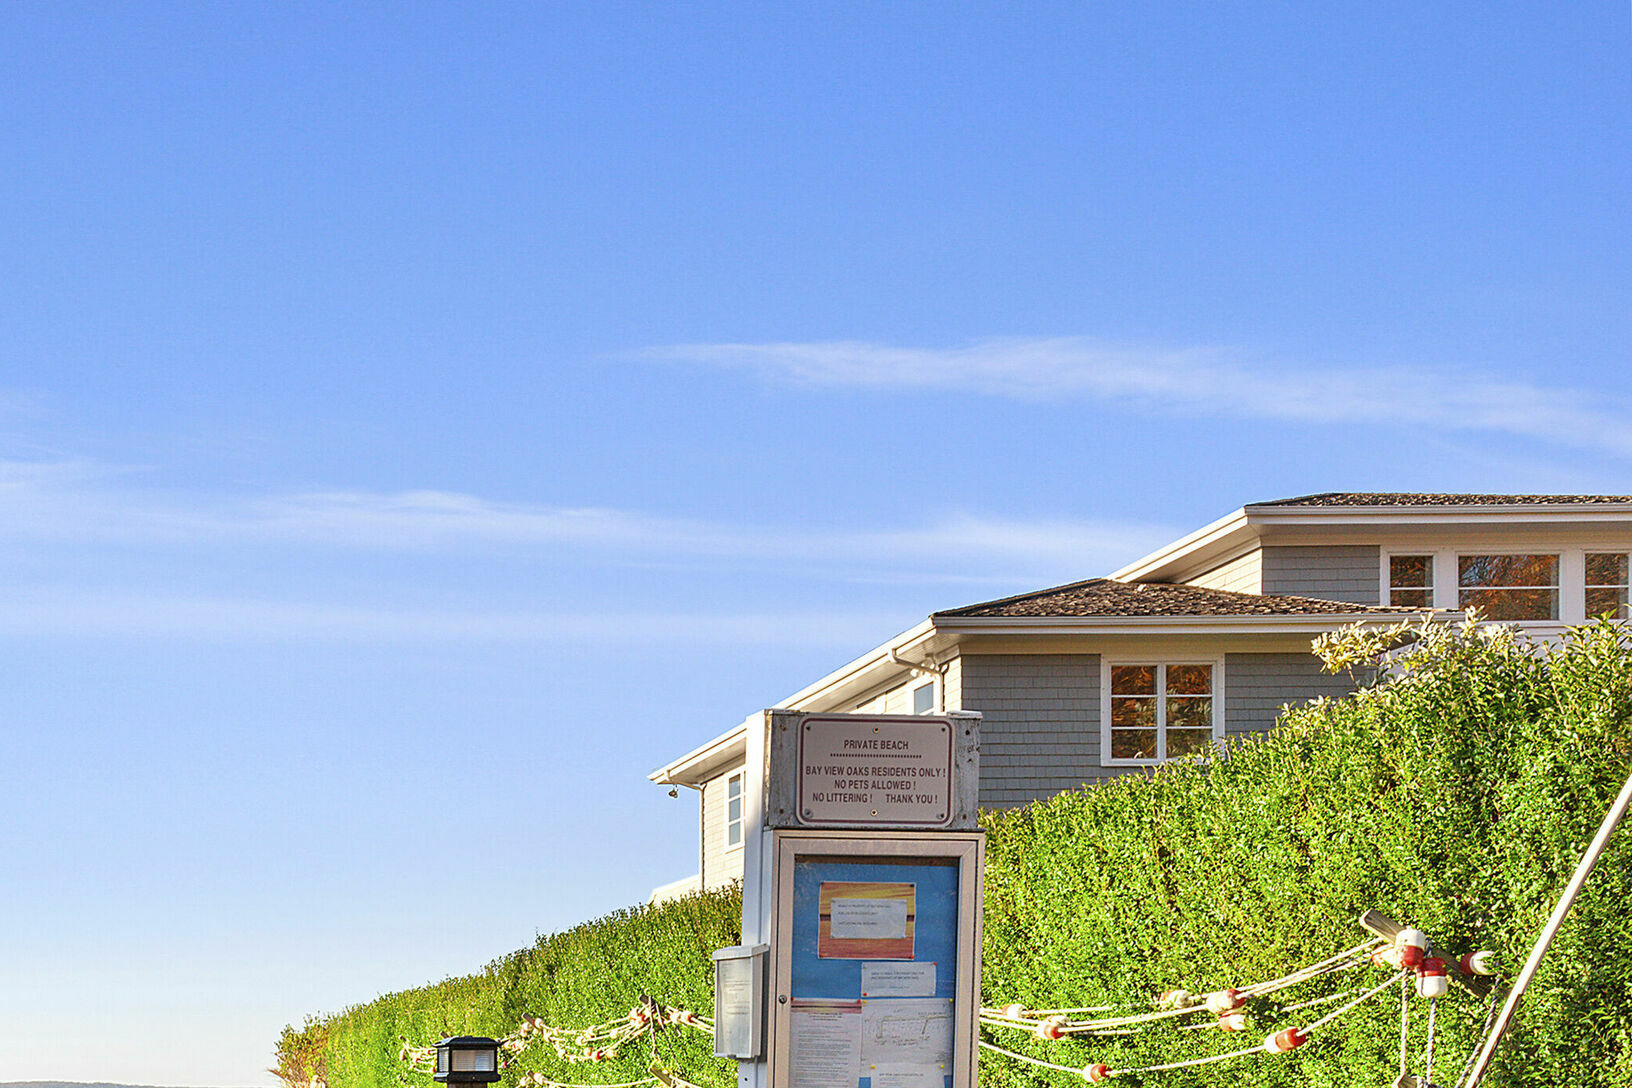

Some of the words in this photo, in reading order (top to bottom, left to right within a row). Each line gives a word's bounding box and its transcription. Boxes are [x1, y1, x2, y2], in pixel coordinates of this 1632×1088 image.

[843, 739, 878, 750] PRIVATE
[880, 740, 909, 750] BEACH
[805, 765, 822, 775] BAY
[824, 765, 845, 776] VIEW
[846, 766, 870, 776] OAKS
[871, 766, 917, 777] RESIDENTS
[834, 779, 847, 789] NO
[848, 779, 869, 790] PETS
[812, 792, 825, 802] NO
[885, 793, 914, 803] THANK
